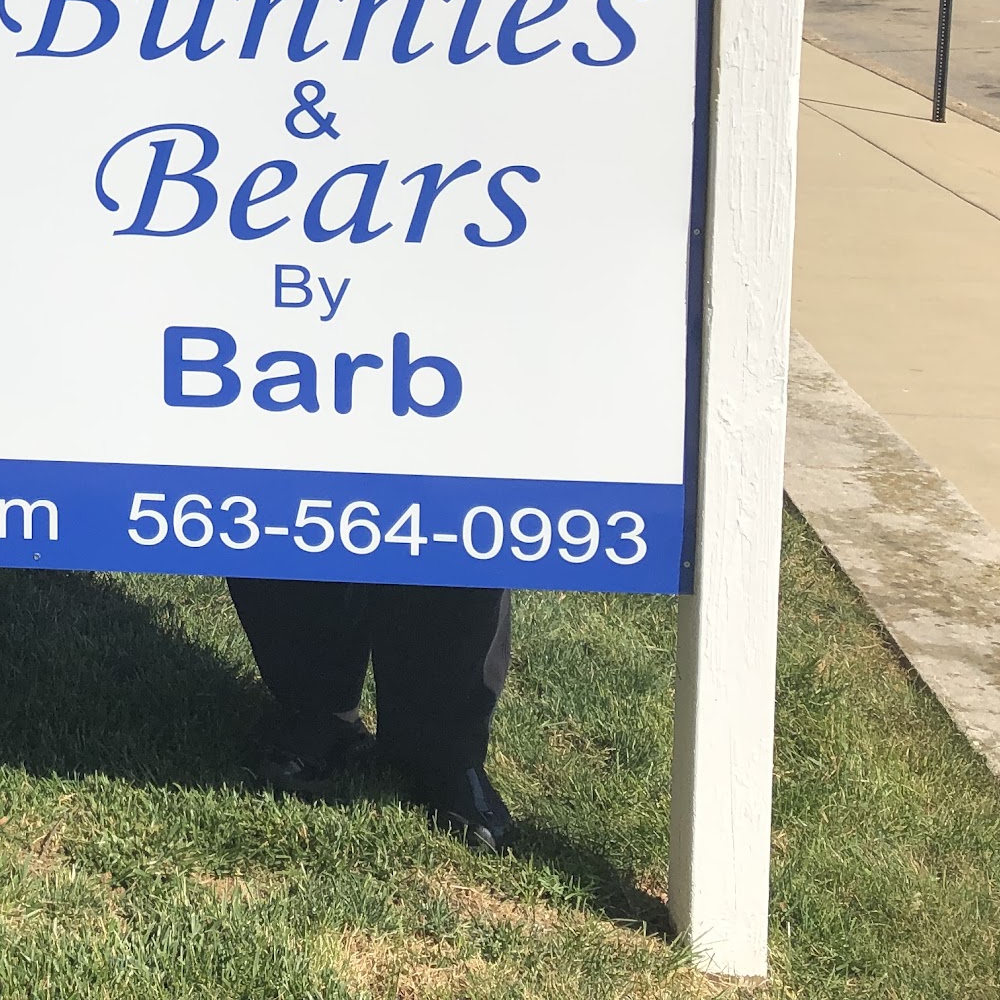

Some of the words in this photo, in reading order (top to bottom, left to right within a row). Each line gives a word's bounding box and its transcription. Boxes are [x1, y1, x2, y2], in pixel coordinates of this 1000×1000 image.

[285, 79, 340, 140] &
[96, 123, 541, 247] Bears
[274, 264, 350, 321] By
[164, 326, 462, 417] Barb
[127, 492, 648, 565] 563-564-0993
